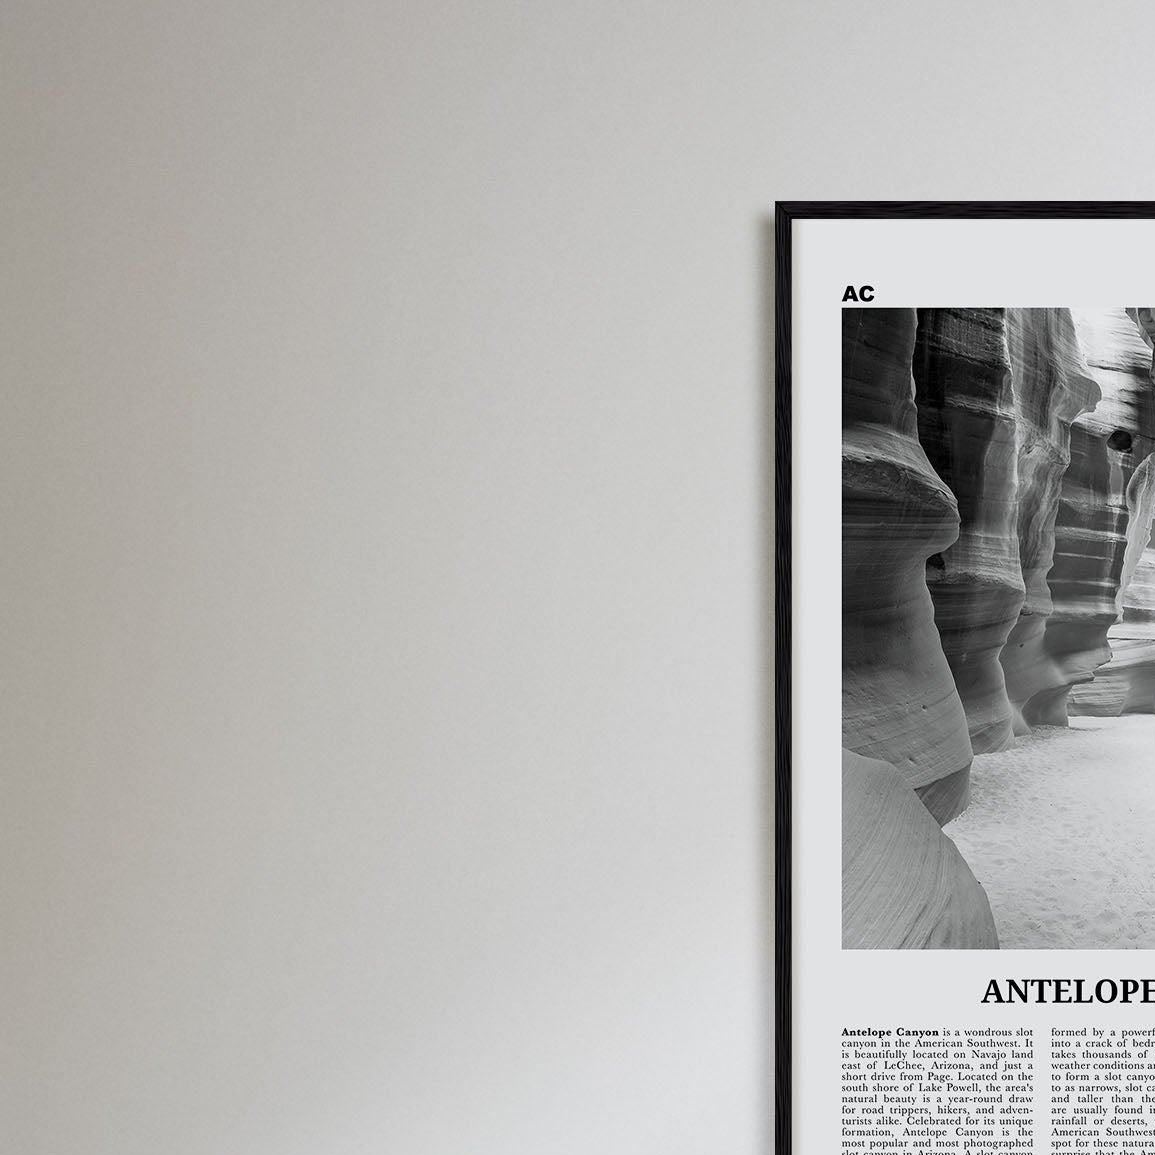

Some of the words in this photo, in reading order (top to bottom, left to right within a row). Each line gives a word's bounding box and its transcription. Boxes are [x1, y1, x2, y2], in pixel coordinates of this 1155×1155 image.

[841, 286, 875, 302] AC
[841, 1028, 892, 1039] Antelope
[896, 1028, 939, 1039] Canyon
[943, 1028, 951, 1036] is
[964, 1028, 1013, 1036] wondrous
[1016, 1028, 1033, 1036] slot
[1051, 1028, 1087, 1036] formed
[1092, 1028, 1104, 1039] by
[841, 1041, 877, 1050] canyon
[881, 1039, 891, 1048] in
[895, 1039, 911, 1048] the
[914, 1039, 963, 1048] American
[967, 1039, 1021, 1048] Southwest.
[1025, 1039, 1033, 1048] It
[1051, 1039, 1071, 1048] into
[1085, 1039, 1112, 1048] crack
[1116, 1039, 1128, 1048] of
[842, 1050, 850, 1059] is
[854, 1050, 907, 1061] beautifully
[912, 1050, 948, 1059] located
[971, 1050, 1007, 1061] Navajo
[1012, 1050, 1033, 1059] land
[1051, 1061, 1091, 1070] weather
[1093, 1061, 1145, 1070] conditions
[841, 1072, 867, 1081] short
[870, 1072, 896, 1081] drive
[900, 1072, 923, 1081] from
[927, 1072, 953, 1084] Page.
[958, 1072, 997, 1081] Located
[1018, 1072, 1034, 1081] the
[1051, 1073, 1061, 1081] to
[1066, 1072, 1089, 1081] form
[1104, 1072, 1122, 1081] slot
[841, 1083, 868, 1092] south
[872, 1083, 899, 1092] shore
[903, 1083, 915, 1092] of
[919, 1083, 942, 1092] Lake
[946, 1083, 982, 1094] Powell,
[986, 1083, 1001, 1092] the
[1005, 1083, 1034, 1092] area's
[1051, 1094, 1070, 1103] and
[1077, 1094, 1104, 1103] taller
[1111, 1094, 1133, 1103] than
[842, 1105, 856, 1114] for
[861, 1105, 884, 1114] road
[890, 1105, 931, 1117] trippers,
[937, 1105, 970, 1116] hikers,
[975, 1105, 994, 1114] and
[1000, 1105, 1033, 1114] adven-
[1051, 1116, 1087, 1125] rainfall
[1110, 1116, 1148, 1127] deserts,
[1051, 1127, 1099, 1136] American
[869, 1139, 909, 1150] popular
[912, 1139, 931, 1147] and
[964, 1139, 1033, 1150] photographed
